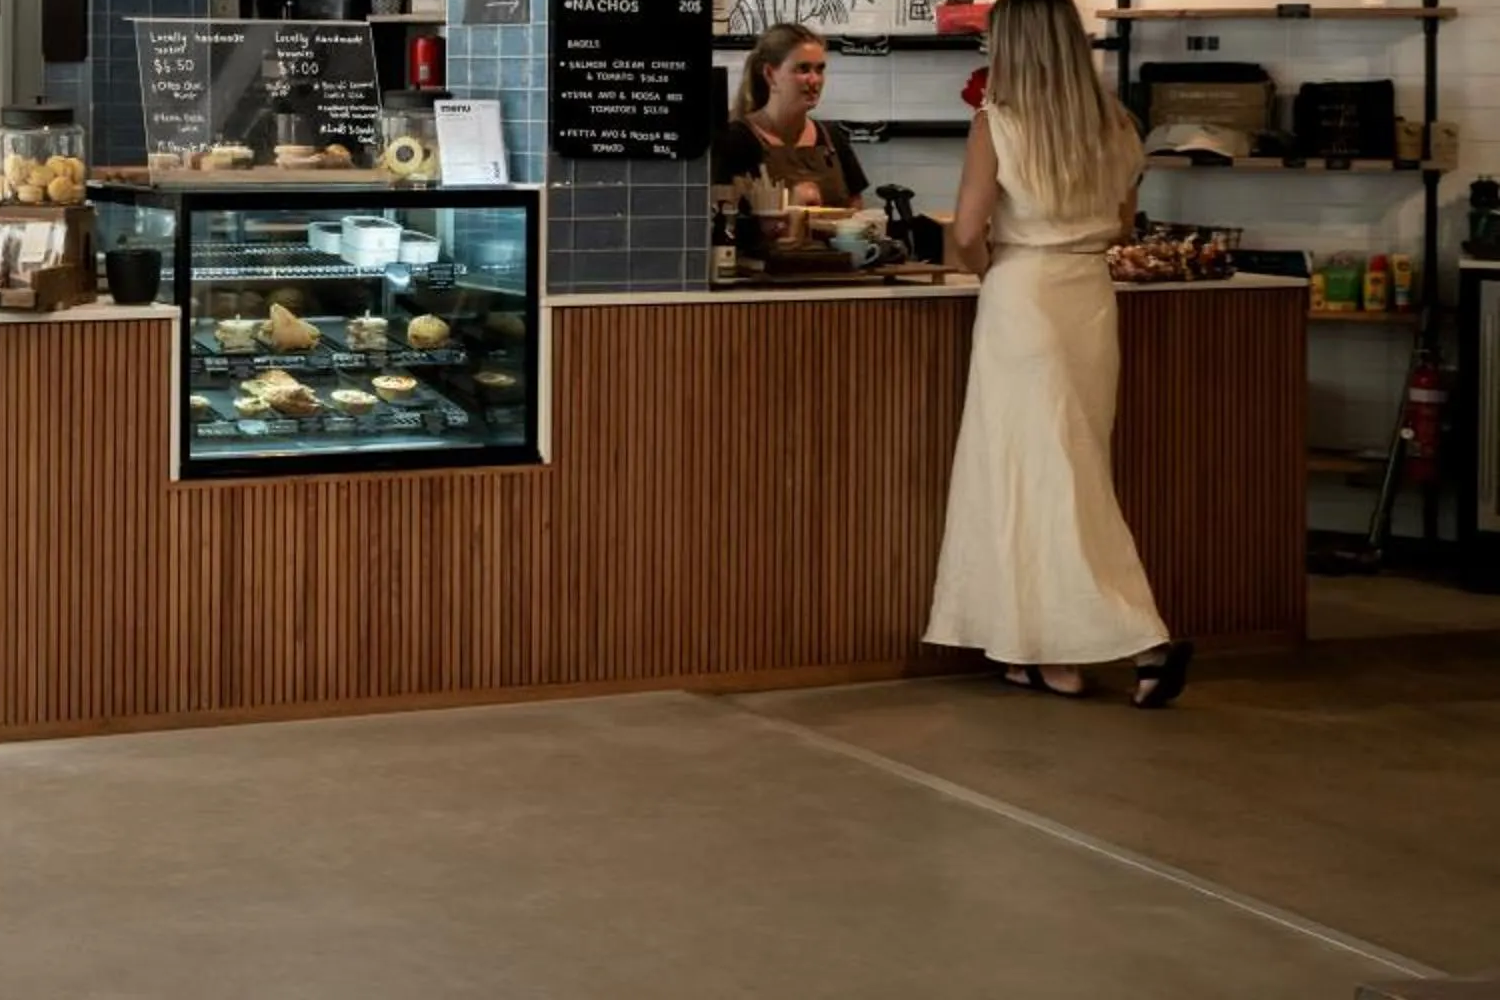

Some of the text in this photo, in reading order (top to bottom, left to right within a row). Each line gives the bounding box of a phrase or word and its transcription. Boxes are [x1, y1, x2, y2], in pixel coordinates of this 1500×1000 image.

[149, 31, 245, 49] Locally handmade
[275, 31, 310, 49] Locally
[567, 38, 601, 49] BAGELS
[568, 60, 608, 71] SALMON
[612, 60, 646, 70] CREAM
[596, 71, 635, 81] TOMATO
[630, 90, 661, 101] NOOSA
[440, 103, 472, 113] menu
[566, 129, 597, 138] FETTA
[601, 129, 619, 139] AVO
[629, 131, 661, 142] NOOSA
